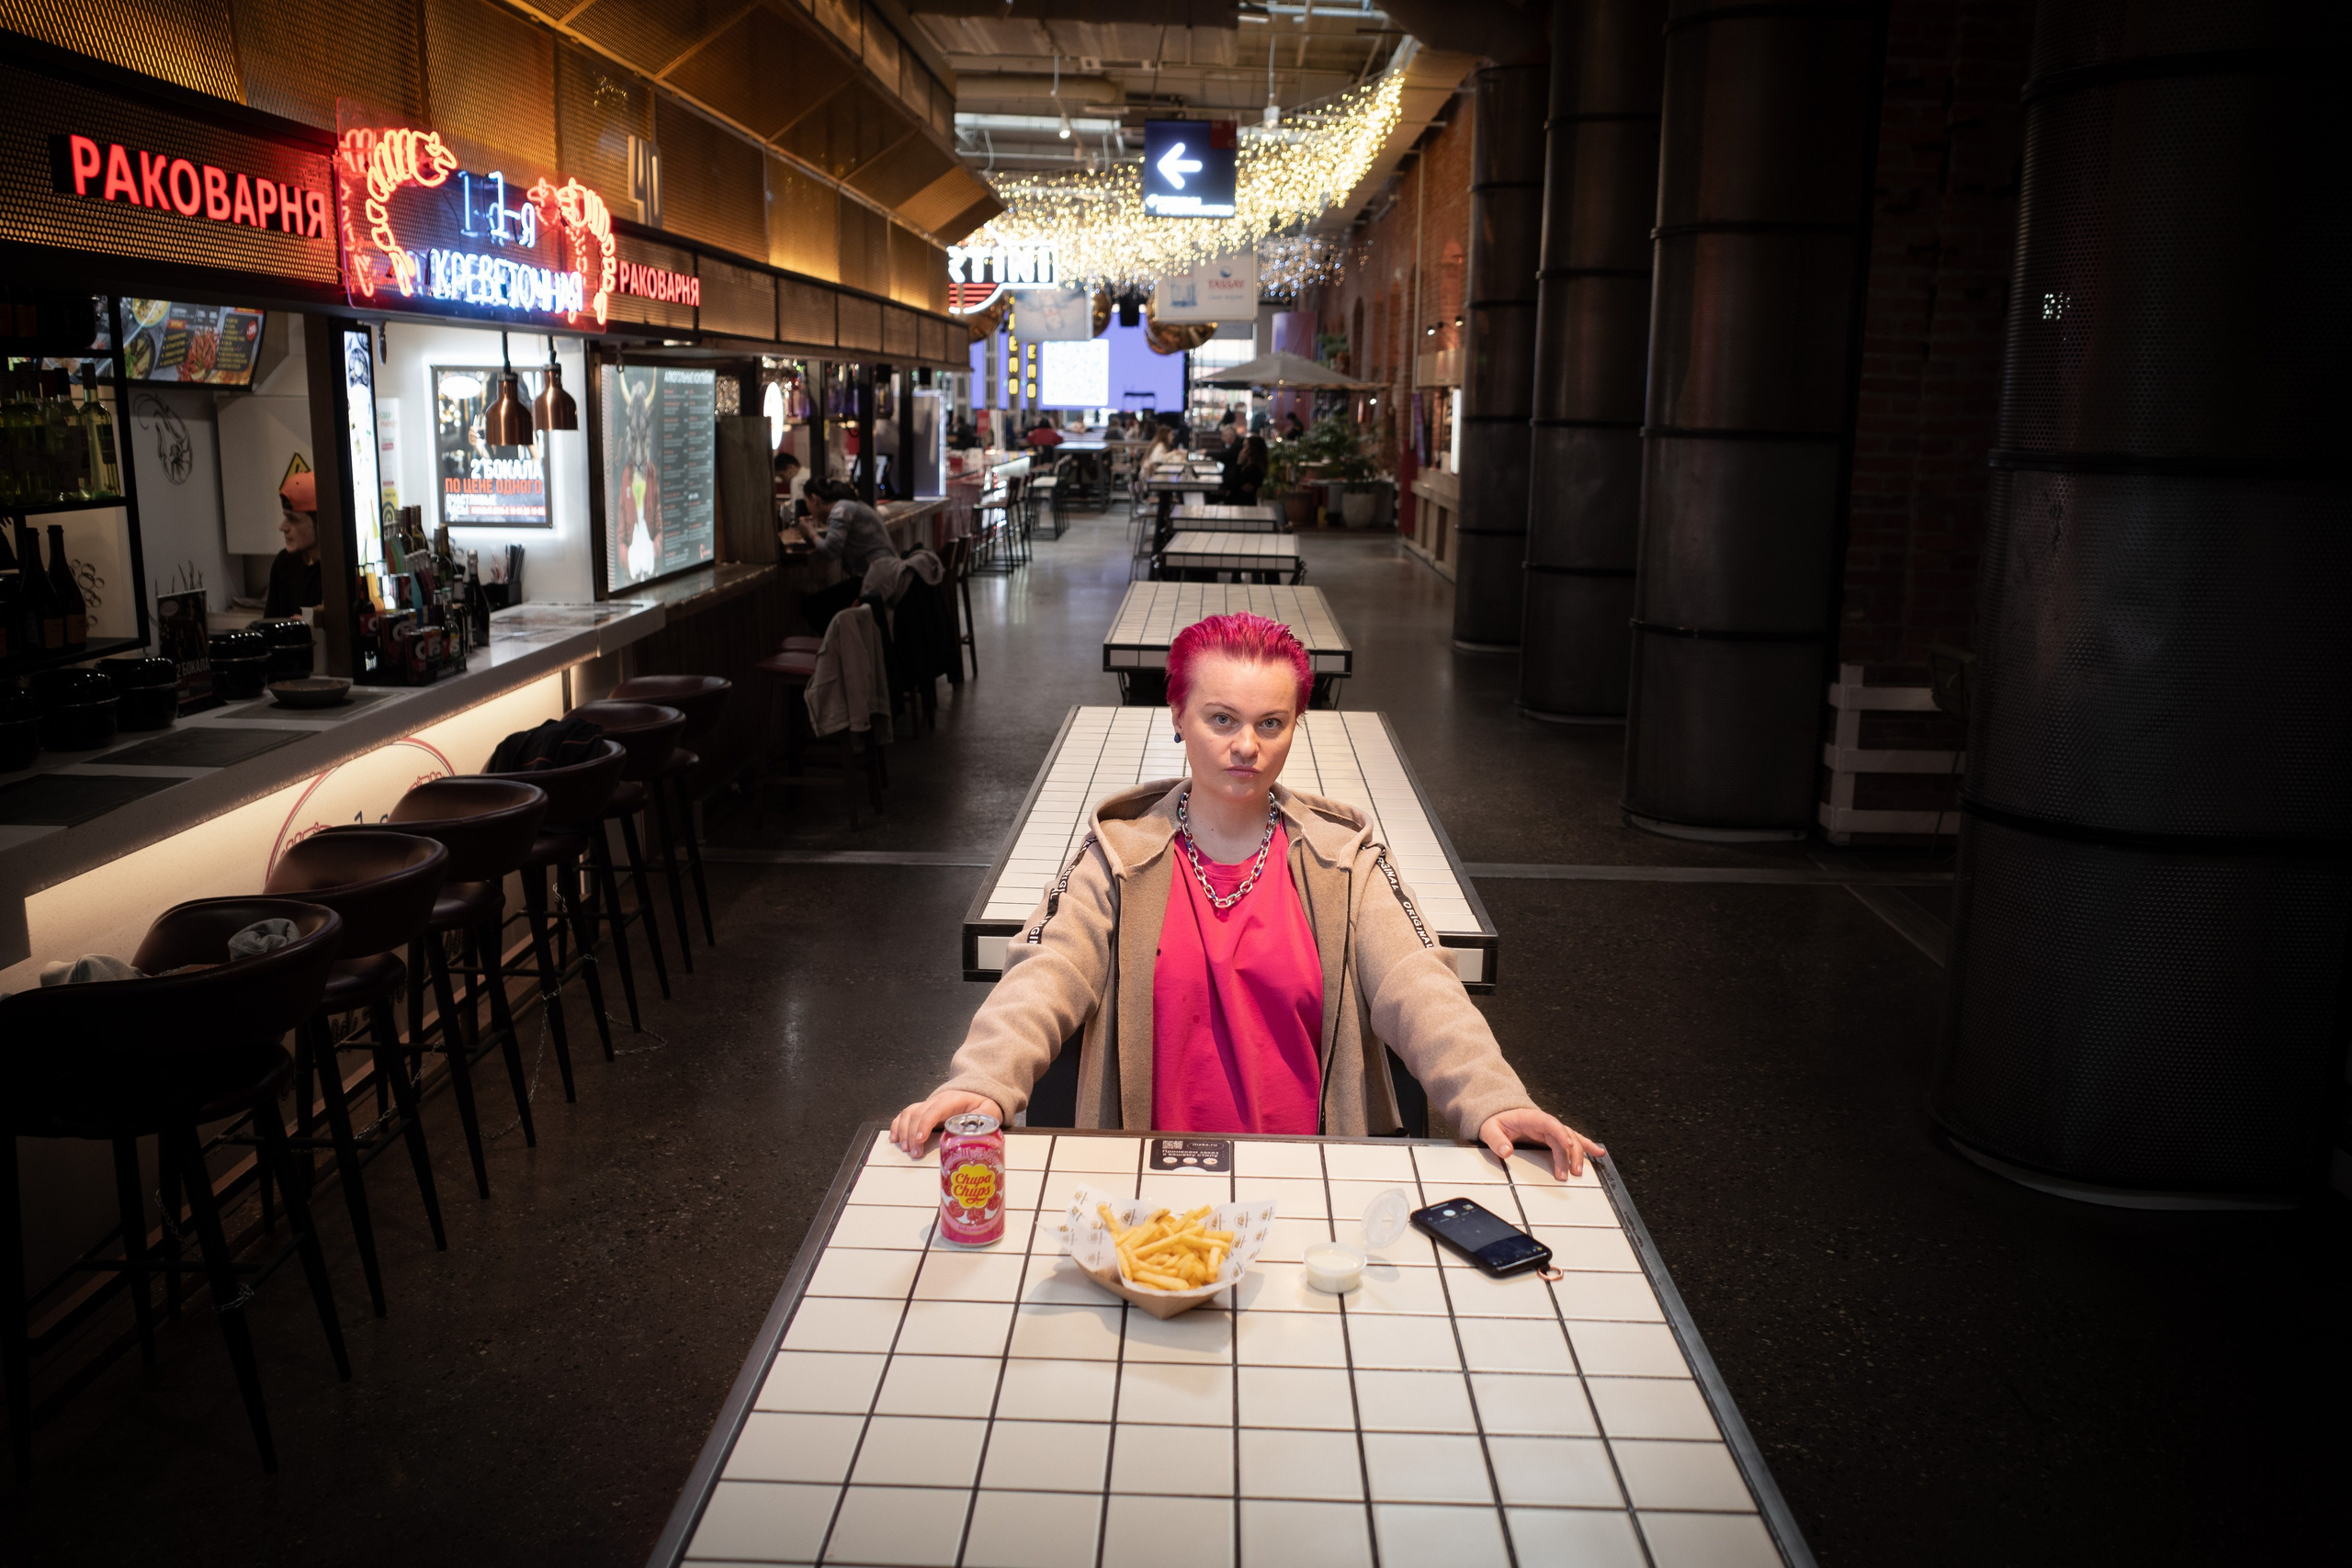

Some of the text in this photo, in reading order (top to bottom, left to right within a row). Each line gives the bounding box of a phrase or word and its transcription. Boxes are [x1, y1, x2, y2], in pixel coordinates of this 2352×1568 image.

[70, 134, 328, 238] РАКОВАРНЯ
[430, 248, 584, 314] КРЕВЕТОЧНАЯ
[619, 260, 700, 307] РАКОВАРНЯ
[1208, 278, 1245, 289] TASSAY
[470, 458, 544, 479] 2 БОКАЛА
[445, 477, 543, 495] ПО ЦЕНЕ ОДНОГО
[1403, 901, 1433, 948] ORIGINAL
[956, 1173, 992, 1188] Chupa
[954, 1184, 990, 1203] Chups
